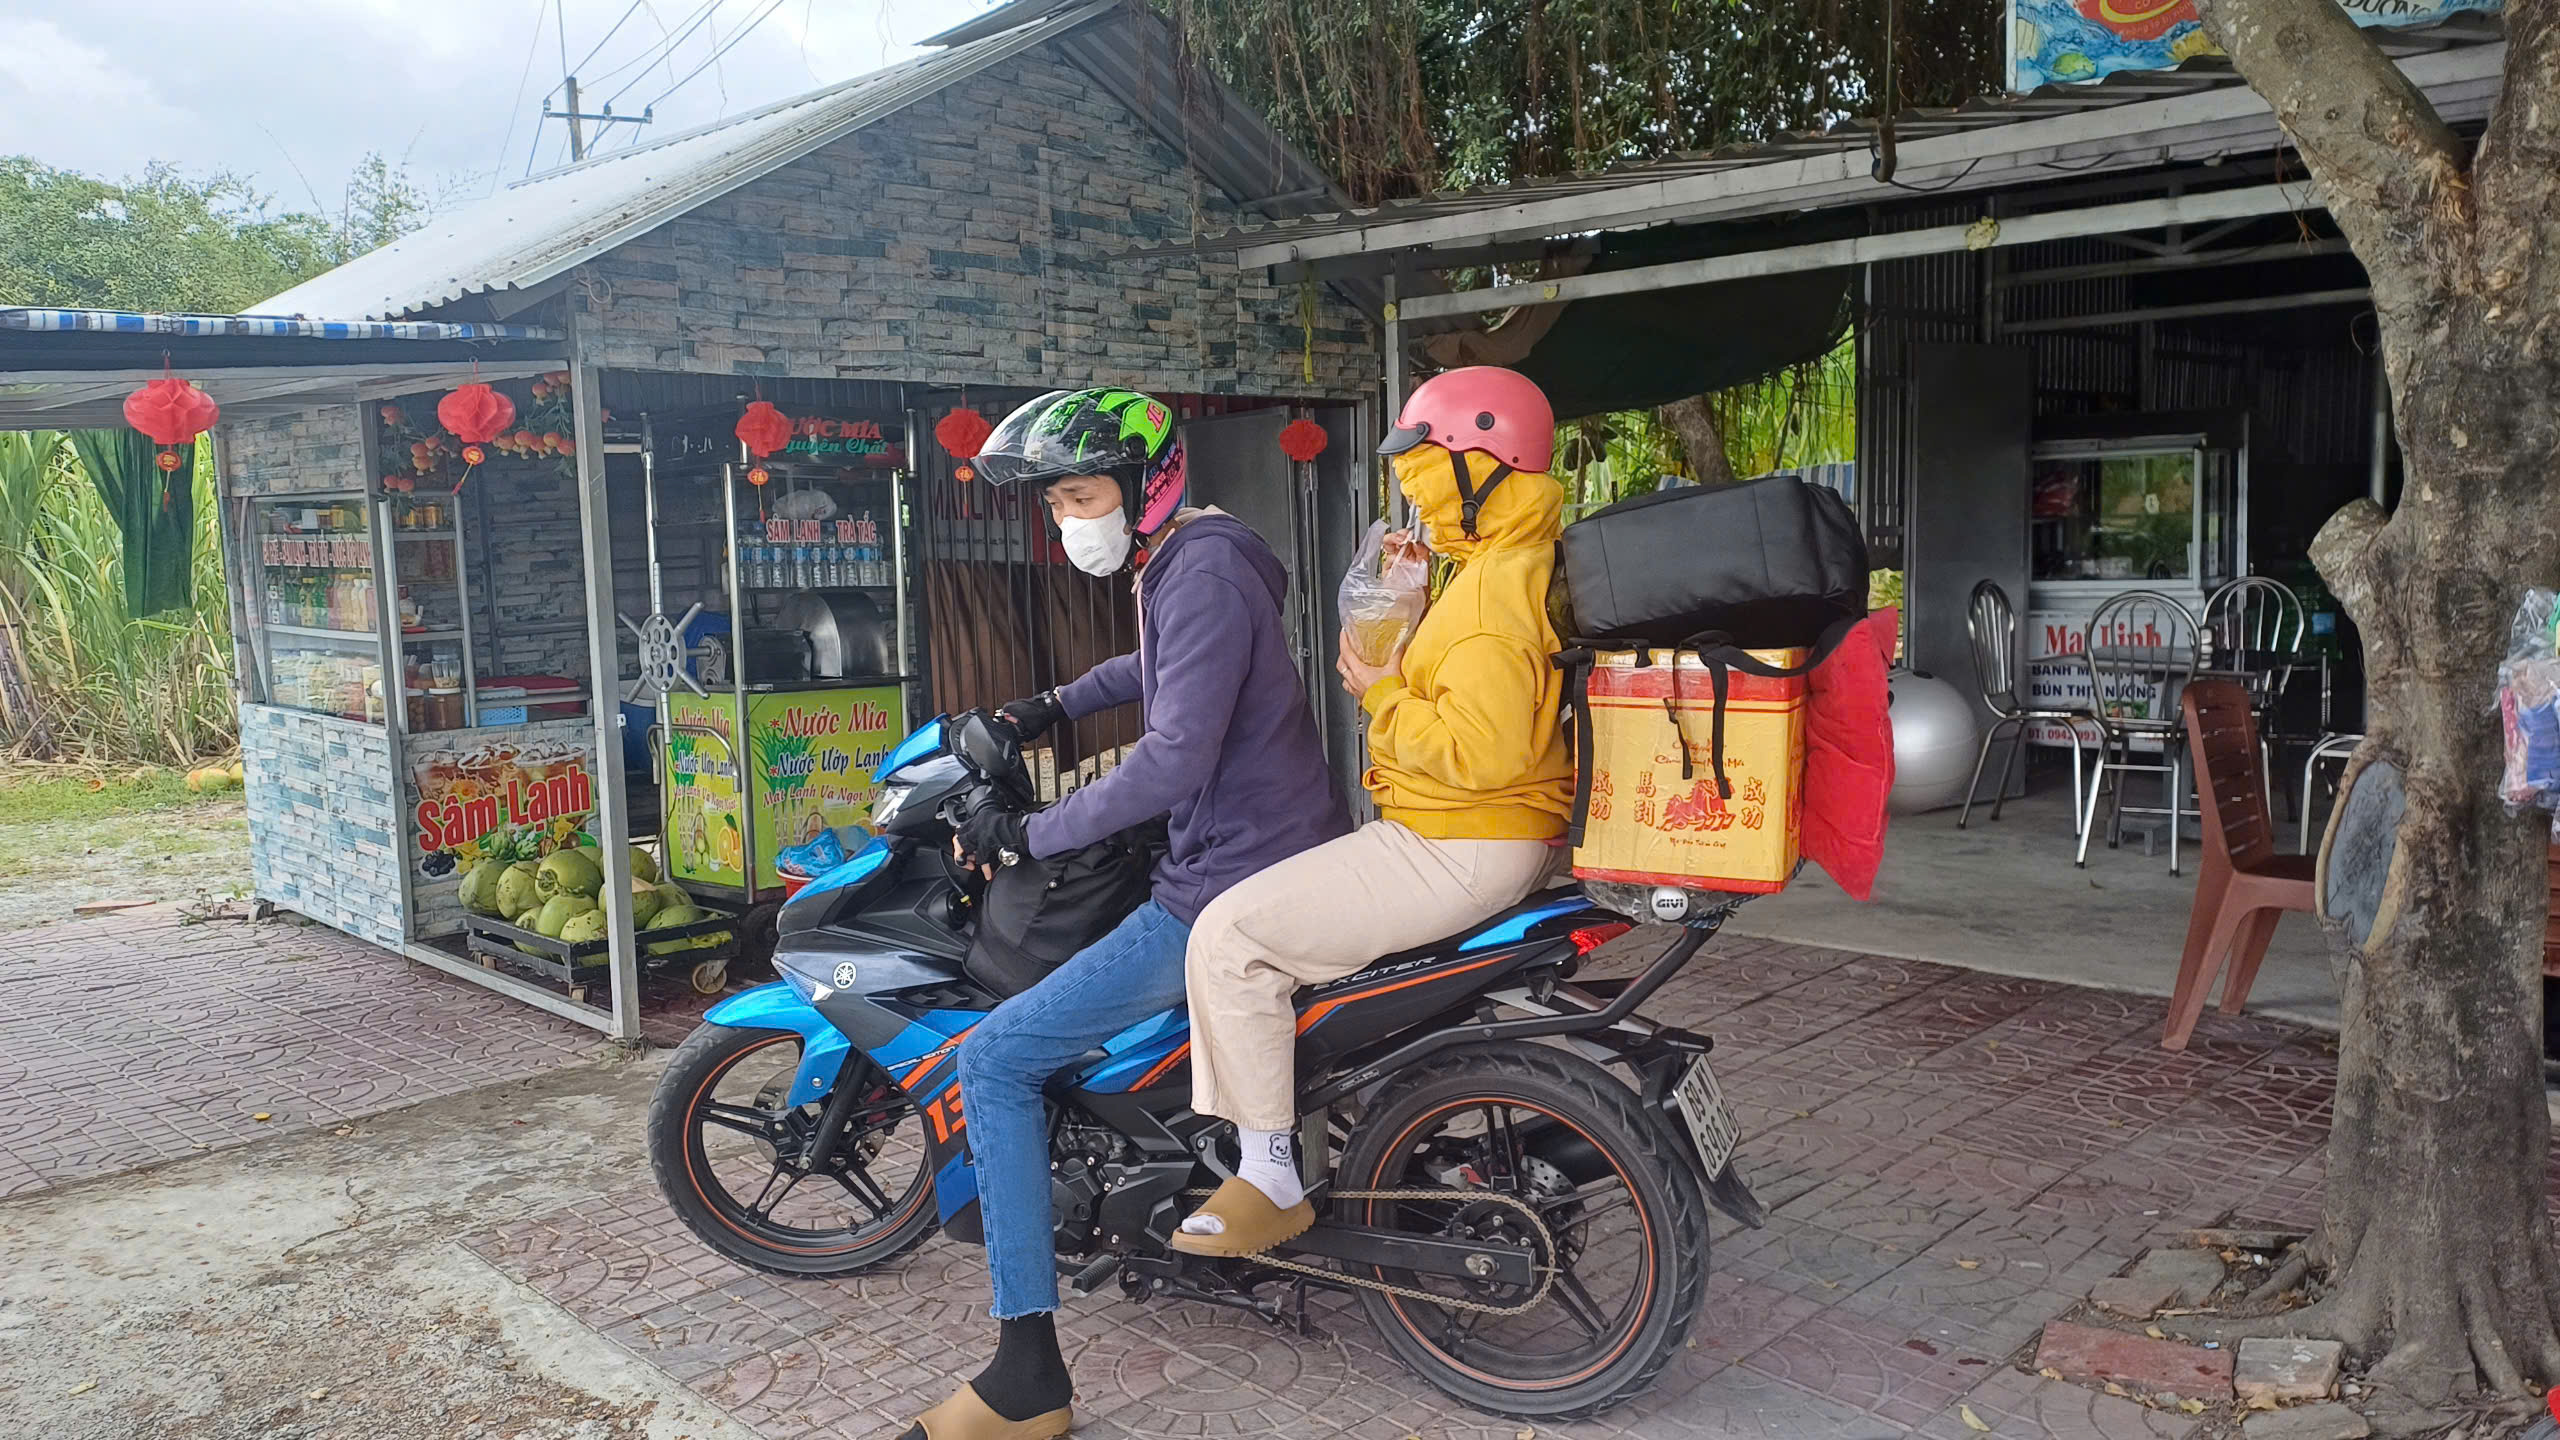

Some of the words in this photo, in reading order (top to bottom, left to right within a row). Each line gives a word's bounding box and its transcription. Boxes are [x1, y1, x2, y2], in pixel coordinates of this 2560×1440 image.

[788, 416, 837, 437] ƯỚC
[785, 437, 841, 454] guyên
[766, 512, 790, 543] SÂM
[835, 513, 857, 544] TRÀ
[2044, 621, 2089, 657] Ma
[2032, 681, 2062, 698] BÚN
[782, 704, 841, 739] Nước
[847, 700, 889, 733] Mía
[776, 752, 816, 778] Nước
[820, 745, 850, 777] Ướp
[417, 794, 499, 852] Sâm
[507, 765, 592, 831] Lạnh
[789, 783, 817, 801] Lạnh
[837, 786, 865, 806] Ngọt
[1312, 956, 1437, 991] EXCITER
